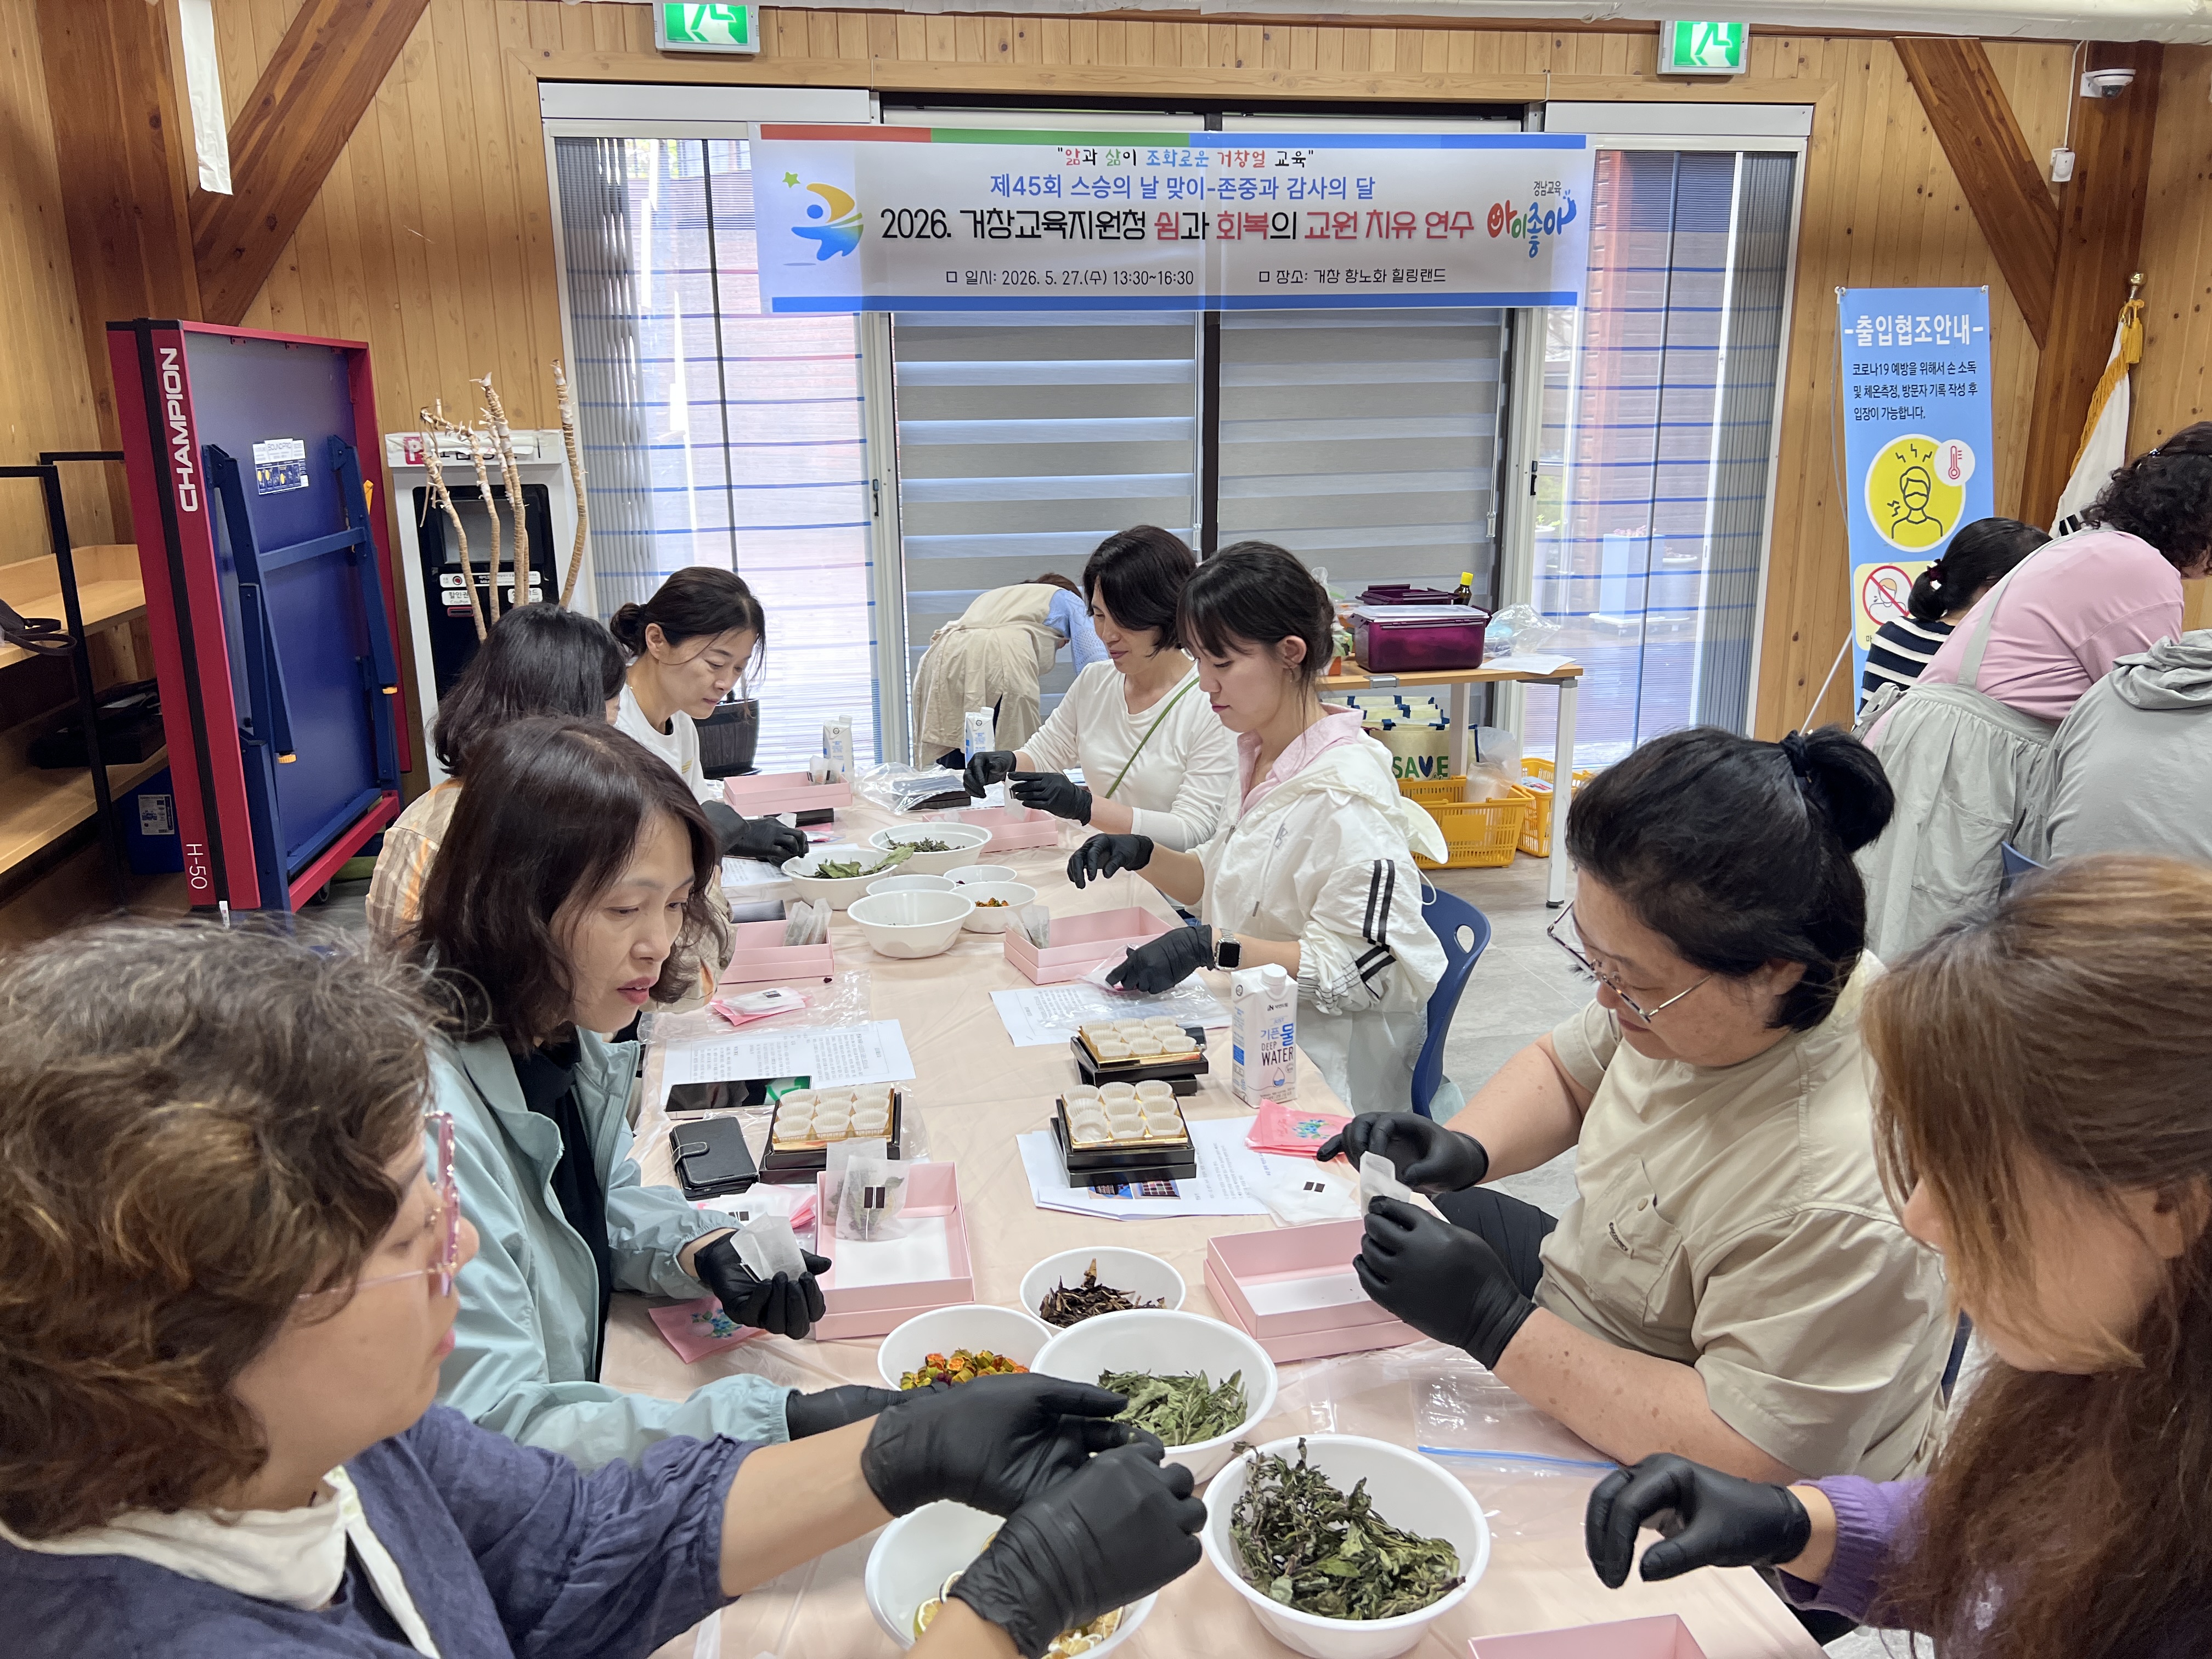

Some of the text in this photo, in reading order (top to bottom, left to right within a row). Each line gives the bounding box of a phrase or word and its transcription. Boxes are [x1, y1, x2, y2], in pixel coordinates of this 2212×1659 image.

[1058, 147, 1314, 168] "앎과 삶이 조화로운 거창얼 교육"
[991, 173, 1375, 200] 제45회 스승의 날 맞이-존중과 감사의 달
[1534, 181, 1561, 196] 경남교육
[881, 208, 1474, 240] 2026. 거창교육지원청 쉼과 회복의 교원 치유 연수
[1487, 196, 1576, 258] 아이좋아
[966, 270, 1193, 285] 일시: 2026. 5. 27.(수) 13:30~16:30
[1276, 268, 1446, 284] 장소: 거창 항노화 힐링랜드
[1853, 361, 1977, 376] 코로나19 예방을 위해서 손 소독
[1854, 382, 1978, 399] 및 체온측정, 방문자 기록 작성 후
[1854, 407, 1926, 421] 입장이 가능합니다.
[160, 348, 198, 512] CHAMPION
[1392, 755, 1448, 778] SAVE
[186, 844, 207, 889] H-50
[1261, 1041, 1277, 1051] DEEP
[1261, 1047, 1294, 1066] WATER
